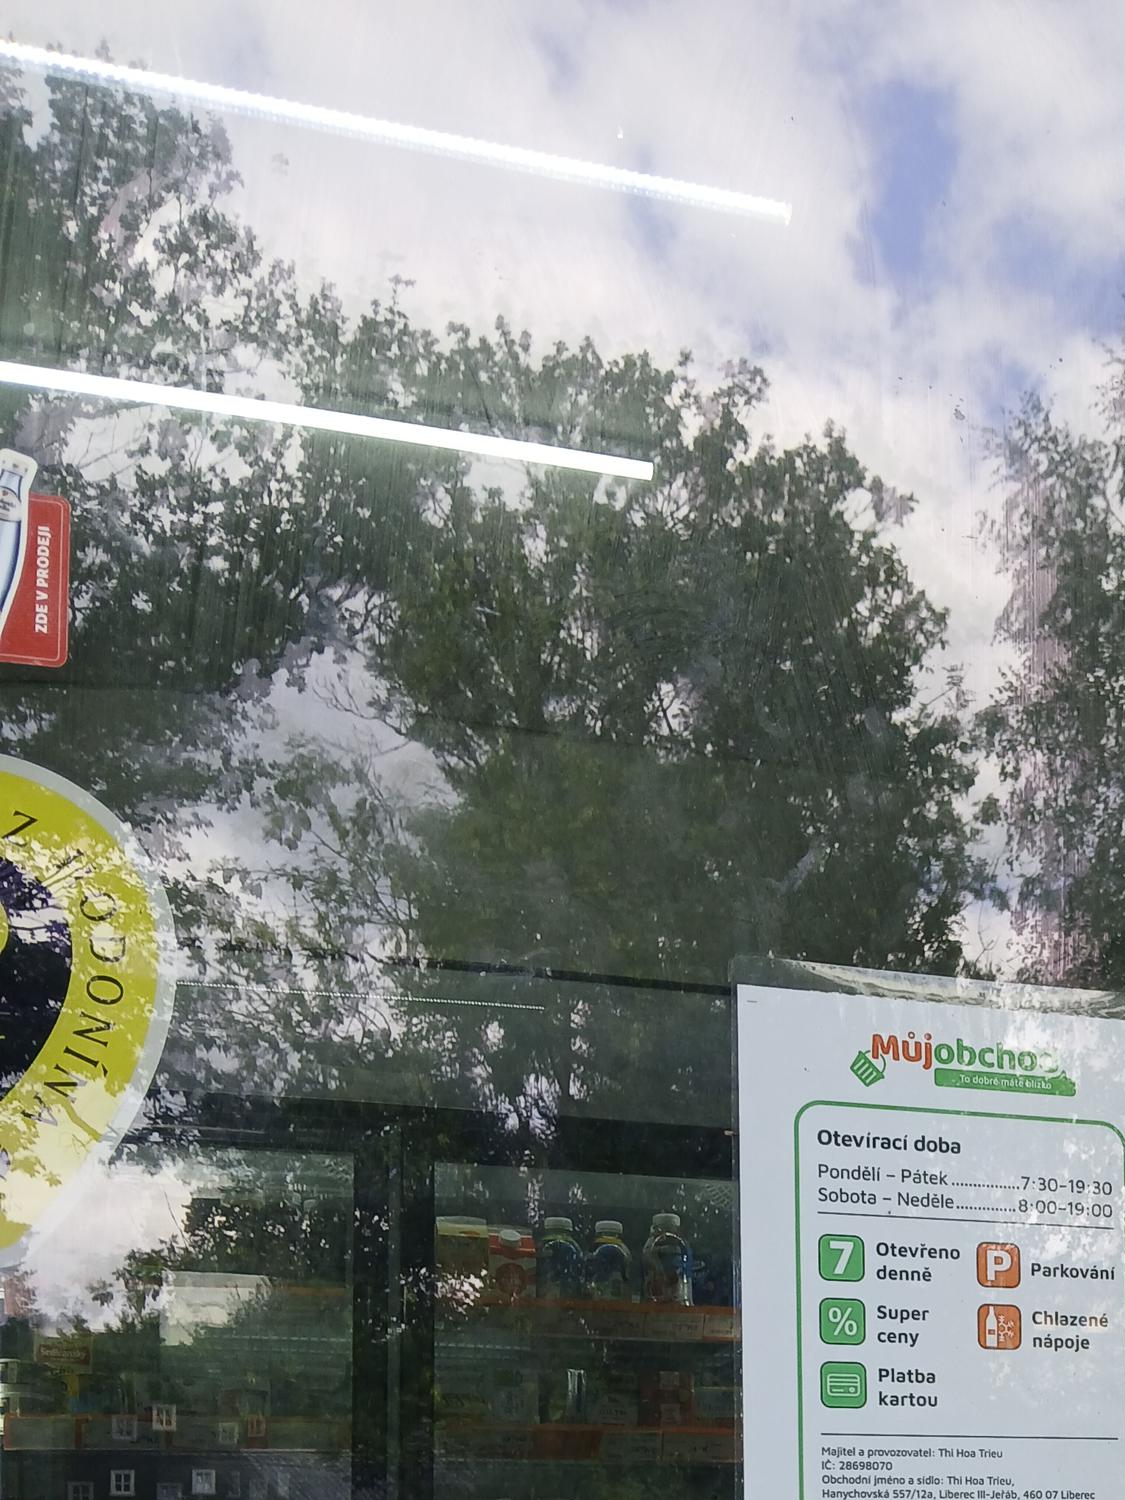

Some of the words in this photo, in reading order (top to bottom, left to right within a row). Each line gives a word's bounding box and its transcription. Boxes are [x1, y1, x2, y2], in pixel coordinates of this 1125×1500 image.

[36, 525, 52, 588] PRODEJI
[35, 605, 49, 635] ZDE
[817, 1129, 908, 1151] Otevírací
[914, 1135, 961, 1154] doba
[818, 1164, 881, 1182] Pondělí
[901, 1169, 949, 1186] Pátek
[818, 1187, 877, 1205] Sobota
[897, 1192, 955, 1209] Neděle
[829, 1241, 853, 1275] 7
[876, 1242, 961, 1262] Otevřeno
[876, 1265, 933, 1283] denně
[986, 1250, 1012, 1281] P
[1031, 1261, 1116, 1282] Parkování
[877, 1305, 929, 1324] Super
[1032, 1310, 1109, 1329] Chlazené
[877, 1330, 920, 1347] ceny
[1033, 1333, 1091, 1352] nápoje
[878, 1368, 936, 1385] Platba
[879, 1391, 938, 1408] kartou
[821, 1447, 856, 1459] Majitel
[858, 1449, 865, 1457] a
[867, 1448, 936, 1459] provozovatel:
[938, 1448, 954, 1458] Thi
[956, 1449, 976, 1458] Hoa
[979, 1449, 1003, 1459] Trieu
[821, 1460, 836, 1471] IČ:
[839, 1461, 893, 1471] 28698070
[822, 1474, 872, 1485] Obchodní
[874, 1475, 905, 1487] jméno
[908, 1477, 914, 1485] a
[917, 1475, 944, 1486] sídlo:
[946, 1476, 963, 1486] Thi
[965, 1476, 985, 1486] Hoa
[987, 1476, 1015, 1487] Trieu,
[822, 1489, 890, 1500] Hanychovská
[892, 1489, 936, 1500] 557/12a,
[939, 1489, 975, 1499] Liberec
[1023, 1490, 1042, 1500] 460
[1045, 1490, 1058, 1500] 07
[1061, 1490, 1096, 1500] Liberec
